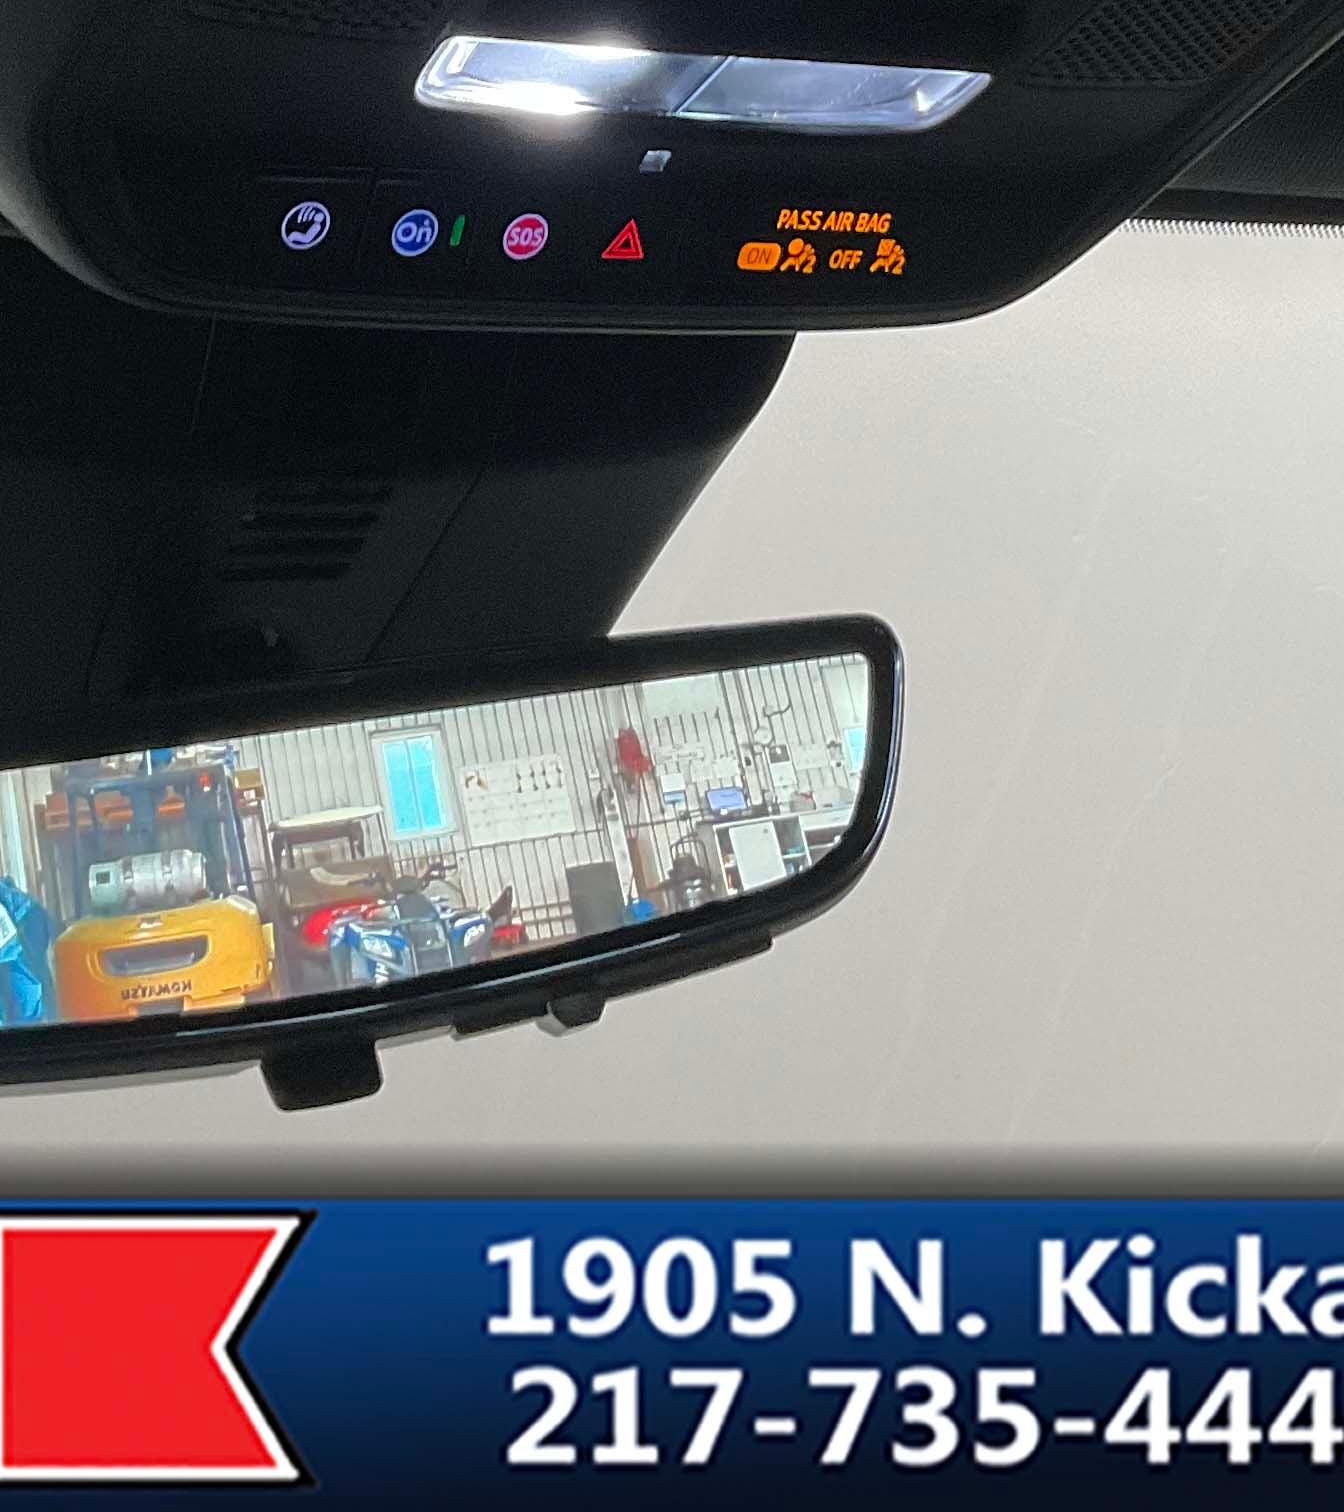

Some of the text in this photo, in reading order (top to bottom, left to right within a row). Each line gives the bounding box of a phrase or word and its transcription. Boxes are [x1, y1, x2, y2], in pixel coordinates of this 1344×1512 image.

[776, 208, 892, 234] PASS AIR BAG
[507, 225, 543, 247] SOS
[746, 247, 864, 270] ON OFF
